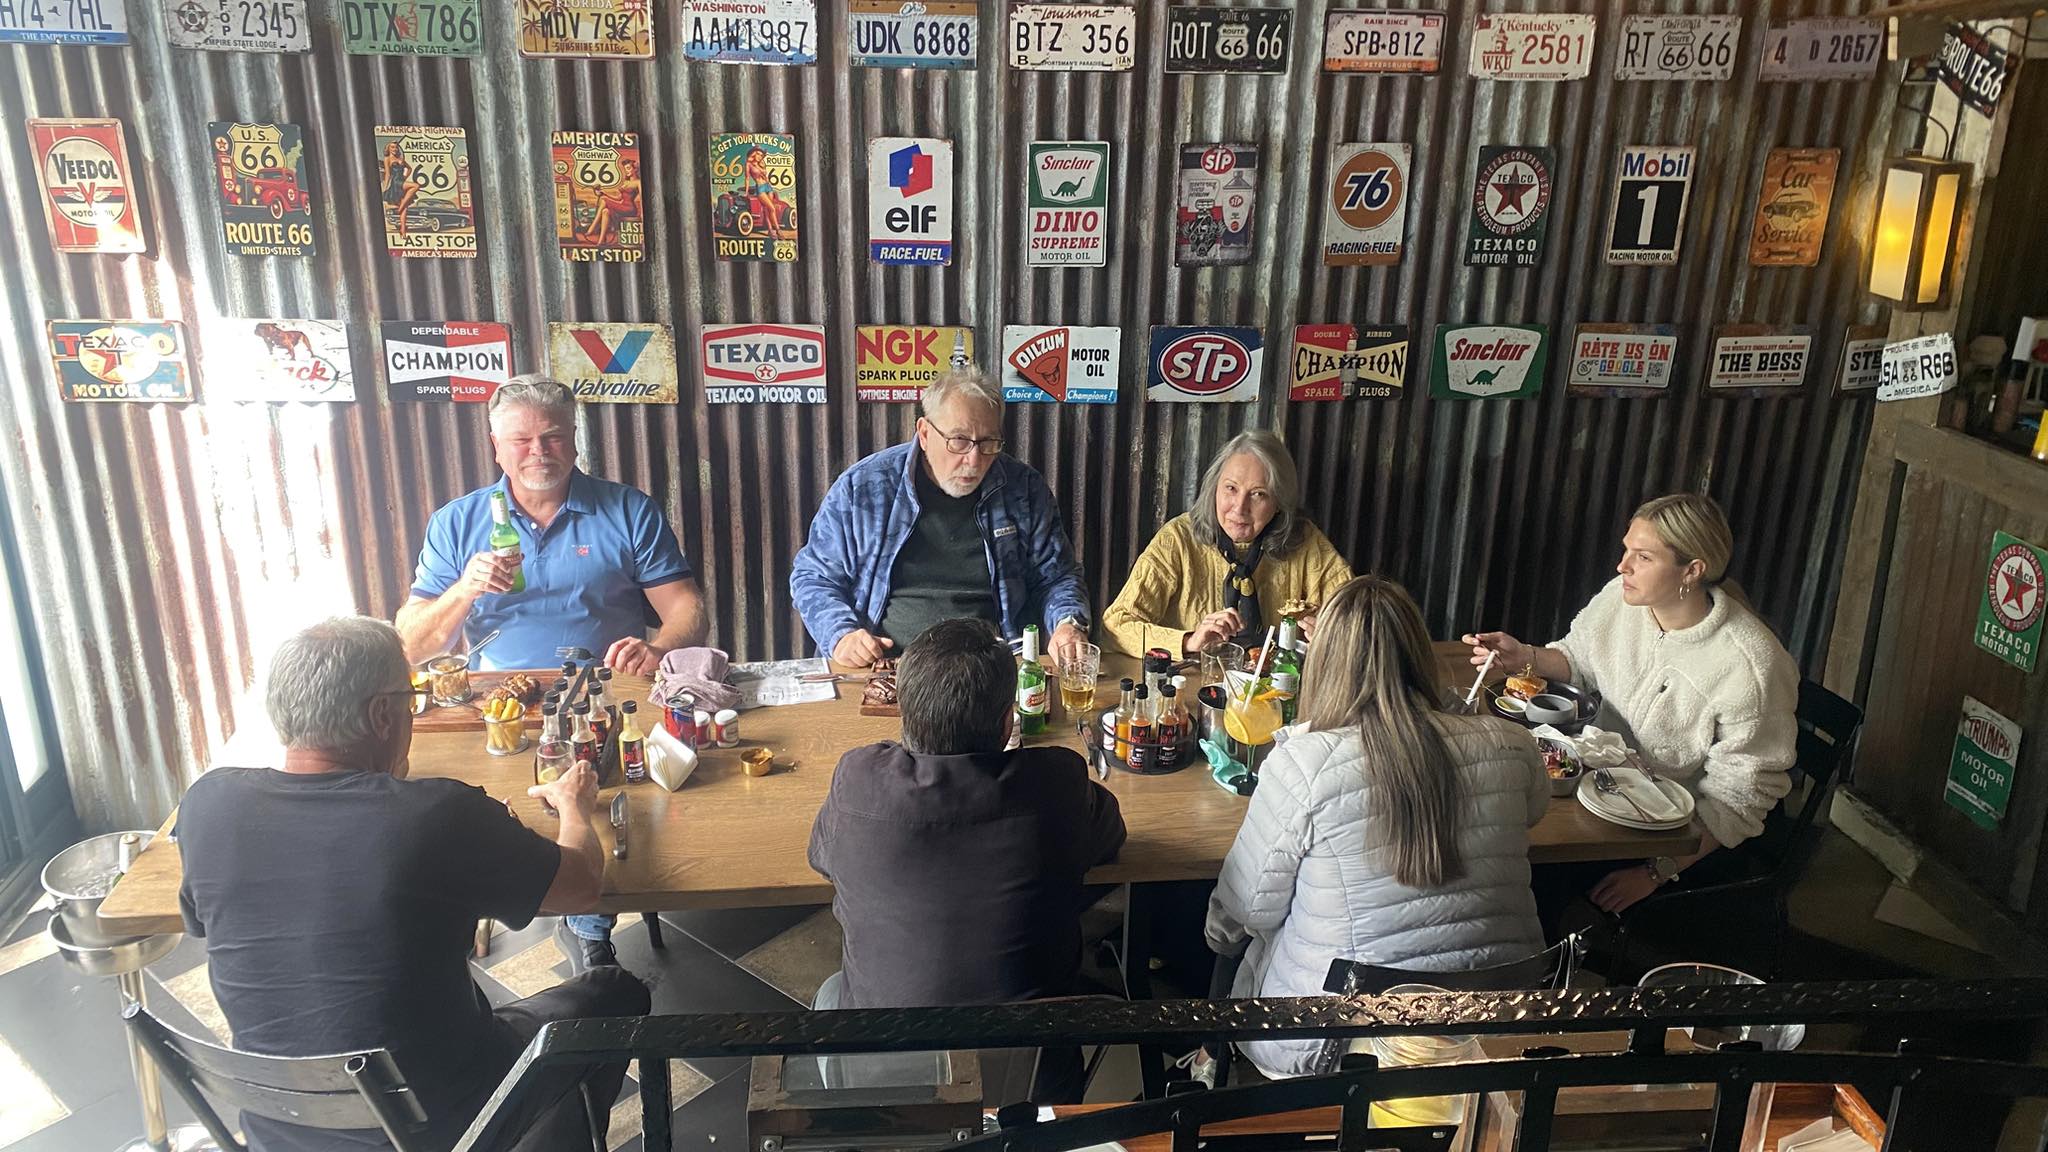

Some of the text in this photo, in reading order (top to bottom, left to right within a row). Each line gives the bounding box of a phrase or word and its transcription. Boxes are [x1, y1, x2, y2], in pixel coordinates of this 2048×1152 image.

[556, 0, 613, 9] FLORIDA
[692, 3, 766, 14] WASHINGTON
[239, 1, 297, 39] 2345
[344, 2, 477, 43] DTX 786
[1041, 7, 1106, 21] Louisiana
[541, 12, 631, 40] MDV 792
[1507, 20, 1561, 33] Kentucky
[20, 32, 38, 40] THE
[233, 40, 277, 49] STATE LODGE
[857, 21, 970, 56] UDK 6868
[1017, 22, 1129, 55] BTZ 356
[1170, 22, 1282, 60] ROT 66
[1388, 31, 1425, 56] 812
[381, 44, 448, 54] ALOHA STATE
[555, 42, 620, 52] SUNSHINE STATE
[1221, 39, 1244, 55] 66
[1522, 34, 1584, 64] 2581
[1623, 31, 1730, 67] RT 66
[1774, 34, 1880, 64] 4 D 2657
[1018, 55, 1028, 65] B
[1364, 61, 1414, 69] PETERSBURG
[1482, 55, 1512, 71] WKU
[1663, 47, 1688, 66] 66
[241, 130, 270, 141] U.S.
[380, 126, 462, 135] AMERICA'S HIGHWAY
[552, 132, 634, 146] AMERICA'S
[405, 141, 451, 151] AMERICA'S
[717, 134, 792, 153] GET YOUR KICKS ON
[241, 145, 278, 170] 66
[412, 154, 445, 163] ROUTE
[577, 151, 614, 159] HIGHWAY
[766, 157, 791, 165] ROUTE
[1042, 155, 1094, 170] Sinclair
[1204, 149, 1232, 171] STP
[1484, 153, 1508, 175] TEXAS
[1511, 151, 1545, 173] COMPANY
[51, 153, 118, 184] VEEDOL
[580, 162, 614, 184] 66
[713, 154, 744, 177] 66
[1623, 152, 1690, 177] Mobil
[412, 164, 449, 188] 66
[767, 167, 792, 187] 66
[1781, 164, 1816, 188] Car
[1342, 166, 1394, 211] 76
[885, 205, 936, 233] elf
[1034, 211, 1098, 232] DINO
[1475, 201, 1545, 235] PETROLEUM PRODUCTS
[1637, 185, 1659, 245] 1
[225, 222, 313, 245] ROUTE 66
[621, 221, 643, 233] LAST
[391, 235, 475, 247] LAST STOP
[720, 239, 766, 257] ROUTE
[1031, 237, 1100, 249] SUPREME
[1329, 242, 1397, 253] RACING FUEL
[1474, 239, 1537, 251] TEXACO
[241, 246, 301, 256] UNITED STATES
[401, 248, 477, 258] AMERICA'S HIGHWAY
[562, 248, 642, 262] LAST STOP
[777, 248, 793, 259] 66
[1075, 252, 1091, 260] OIL
[1471, 253, 1534, 264] MOTOR OIL
[411, 327, 479, 336] DEPENDABLE
[709, 343, 818, 363] TEXACO
[858, 329, 939, 366] NGK
[1016, 333, 1065, 368] OILZUM
[1071, 349, 1110, 361] MOTOR
[1450, 338, 1530, 361] Sinclair
[1580, 341, 1670, 360] RATE US ON
[391, 352, 504, 371] CHAMPION
[1170, 342, 1237, 383] STP
[1295, 345, 1405, 381] CHAMPION
[1599, 360, 1644, 373] GOOGLE
[1719, 351, 1803, 372] THE BOSS
[859, 370, 938, 380] SPARK PLUGS
[1087, 364, 1104, 377] OIL
[72, 383, 179, 397] MOTOR OIL
[416, 386, 486, 394] SPARK PLUGS
[572, 379, 660, 396] Valvoline
[705, 387, 827, 403] TEXACO MOTOR OIL
[858, 389, 890, 400] OPTIMISE
[892, 389, 918, 400] ENGINE
[1006, 389, 1031, 399] Choice
[1034, 391, 1044, 400] of
[1305, 387, 1390, 397] SPARK PLUGS
[1893, 385, 1931, 397] AMERICA
[1984, 620, 2031, 655] TEXACO
[1981, 634, 2029, 668] MOTOR OIL
[1968, 719, 2011, 758] TRIUMPH
[1961, 751, 2005, 787] MOTOR
[1970, 773, 1988, 790] OIL
